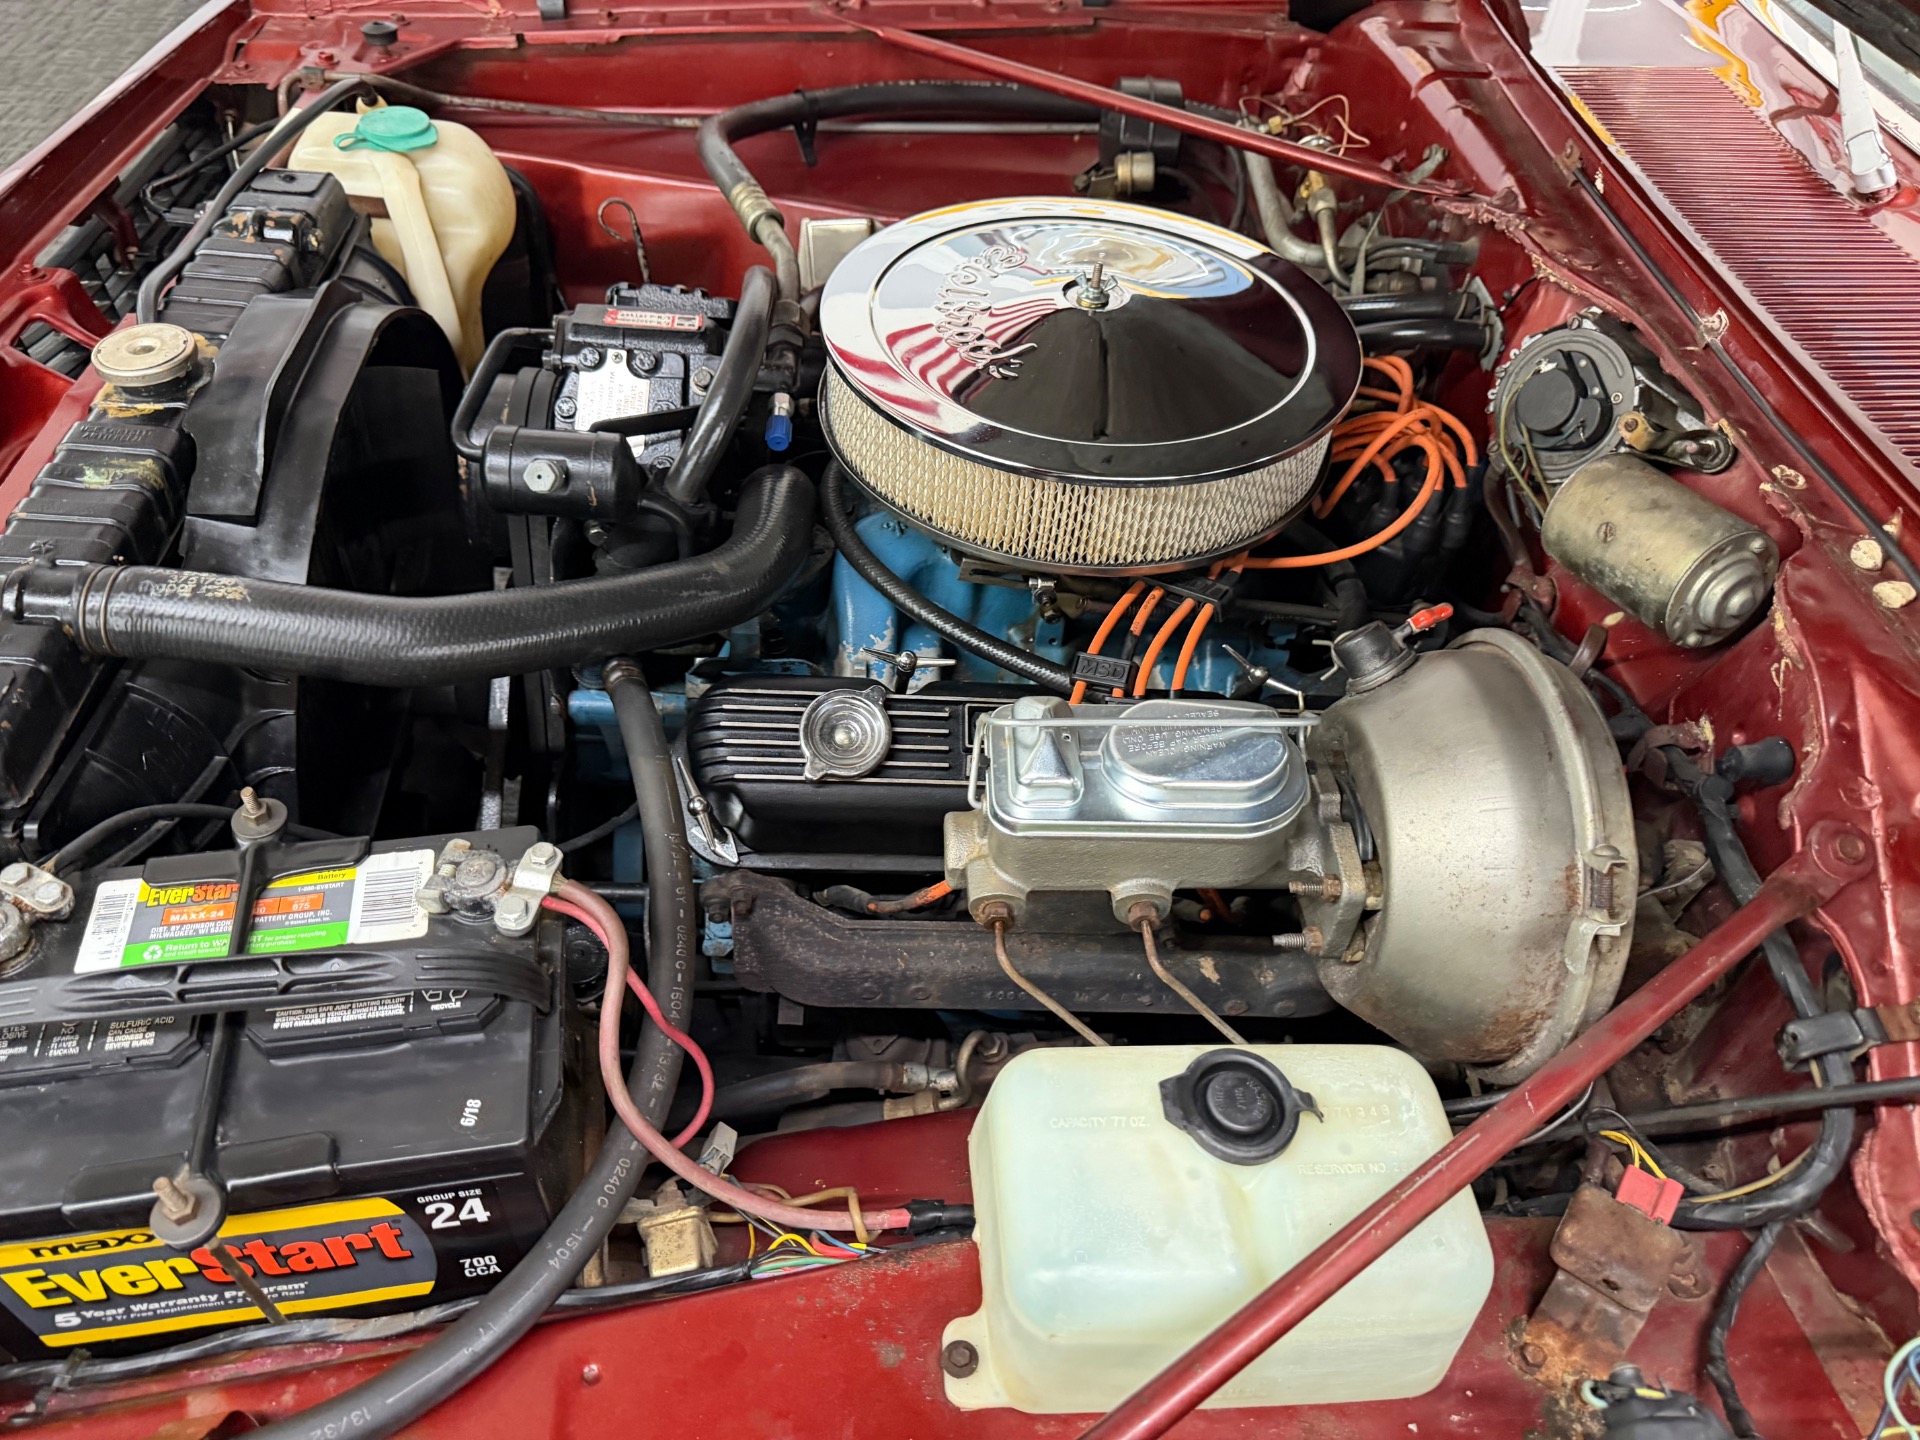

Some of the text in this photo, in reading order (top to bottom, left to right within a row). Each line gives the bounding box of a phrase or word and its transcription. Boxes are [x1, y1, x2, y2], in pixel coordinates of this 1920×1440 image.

[1080, 658, 1126, 680] MSD
[1128, 740, 1165, 752] BEFORE
[1169, 737, 1188, 746] CAP
[317, 872, 347, 880] Battery
[170, 910, 225, 922] MAXX-24
[180, 922, 216, 932] JOHNSON
[316, 908, 333, 918] INC.
[164, 942, 195, 952] Return
[199, 940, 212, 948] to
[318, 1005, 334, 1013] SAFE
[352, 1000, 380, 1010] STARTING
[381, 997, 406, 1005] FOLLOW
[431, 1001, 462, 1011] RECYCLE
[670, 986, 684, 1020] 1504
[280, 1020, 294, 1029] NOT
[294, 1016, 326, 1028] AVAILABLE
[326, 1014, 342, 1024] SEEK
[342, 1012, 367, 1022] SERVICE
[326, 1008, 351, 1018] VEHICLE
[110, 1016, 174, 1030] SULFURIC ACID
[106, 1033, 144, 1043] BLINDNESS
[108, 1026, 148, 1036] CAN CAUSE
[104, 1038, 154, 1050] SEVERE BURNS
[650, 1048, 672, 1093] 13/32
[1246, 1077, 1267, 1120] WASHER
[460, 1098, 482, 1127] 6/18
[1050, 1115, 1151, 1129] CAPACITY 77 OZ.
[602, 1157, 632, 1194] 0240
[1298, 1162, 1366, 1175] RESERVOIR
[1369, 1162, 1391, 1174] NO.
[416, 1188, 482, 1204] GROUP SIZE
[424, 1197, 491, 1230] 24
[546, 1228, 582, 1274] 1504
[0, 1222, 412, 1309] EverStart
[460, 1254, 498, 1269] 700
[464, 1264, 502, 1278] CCA
[54, 1311, 82, 1328] 5
[80, 1307, 125, 1319] Year
[130, 1292, 219, 1312] Warranty
[156, 1300, 225, 1316] Replacement
